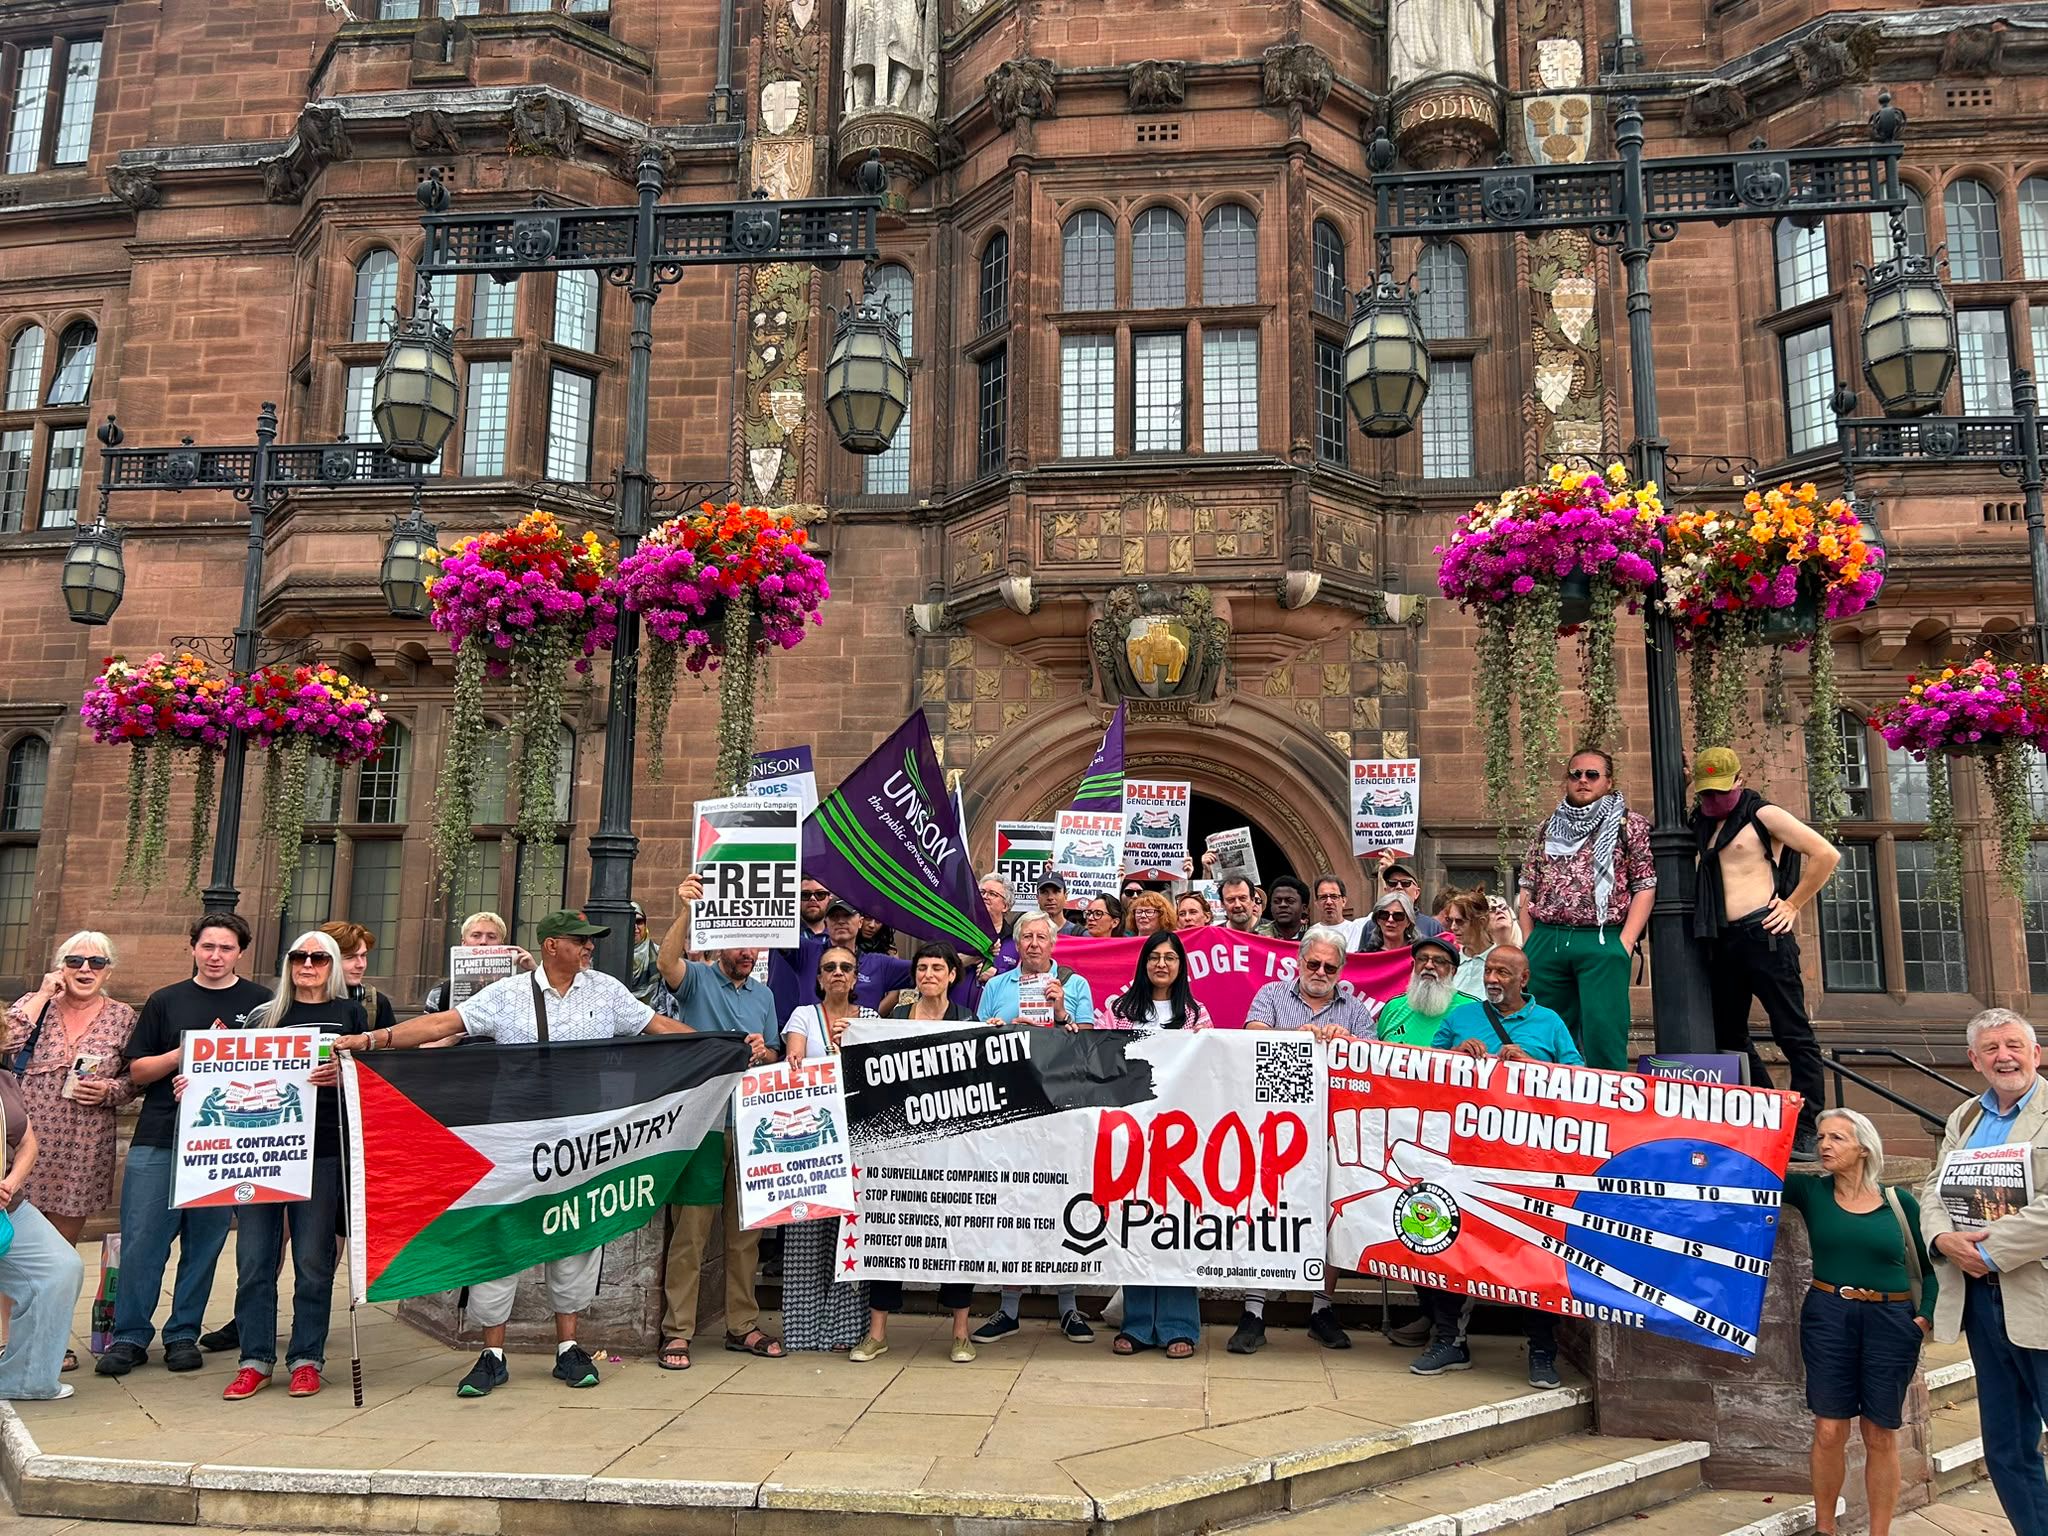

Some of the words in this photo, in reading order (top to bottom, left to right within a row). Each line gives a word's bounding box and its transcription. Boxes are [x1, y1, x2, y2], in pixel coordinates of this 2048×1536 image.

[749, 757, 800, 777] NISON
[1354, 763, 1416, 778] DELETE
[1354, 777, 1396, 785] GENOCIDE
[1126, 784, 1187, 800] DELETE
[701, 802, 728, 812] Palestine
[729, 801, 762, 810] Solidarity
[763, 800, 797, 810] Campaign
[1126, 797, 1165, 806] GENOCIDE
[1166, 798, 1186, 807] TECH
[883, 769, 957, 865] UNISON
[1061, 815, 1123, 831] DELETE
[1355, 821, 1380, 829] CANCEL
[1381, 820, 1414, 829] CONTRACTS
[1060, 827, 1098, 837] GENOCIDE
[1101, 829, 1121, 837] TECH
[1354, 829, 1373, 837] WITH
[1374, 829, 1394, 838] CISCO,
[1394, 828, 1415, 836] ORACLE
[867, 795, 884, 812] the
[878, 812, 907, 840] public
[904, 840, 925, 867] service
[922, 864, 940, 887] union
[1124, 841, 1147, 849] CANCEL
[1147, 842, 1183, 850] CONTRACTS
[1374, 837, 1404, 845] PALANTIR
[1140, 850, 1160, 859] CISCO,
[1140, 859, 1171, 867] PALANTIR
[695, 863, 796, 899] FREE
[1079, 871, 1117, 880] CONTRACTS
[1072, 880, 1091, 889] CISCO,
[1092, 881, 1117, 889] ORACLE
[695, 899, 795, 917] PALESTINE
[696, 920, 711, 929] END
[713, 919, 744, 928] ISRAELI
[745, 919, 794, 928] OCCUPATION
[472, 948, 513, 956] Socialist
[455, 959, 483, 968] PLANET
[484, 958, 511, 967] BURNS
[466, 966, 491, 975] PROFITS
[193, 1035, 311, 1061] DELETE
[192, 1059, 269, 1073] GENOCIDE
[273, 1059, 311, 1070] TECH
[864, 1039, 977, 1087] COVENTRY
[985, 1030, 1031, 1066] CITY
[741, 1062, 836, 1098] DELETE
[1327, 1037, 1498, 1090] COVENTRY
[1503, 1060, 1646, 1113] TRADES
[1653, 1079, 1783, 1131] UNION
[1330, 1077, 1346, 1090] EST
[1347, 1078, 1371, 1094] 1889
[742, 1089, 803, 1108] GENOCIDE
[804, 1084, 838, 1098] TECH
[904, 1082, 1008, 1126] COUNCIL:
[1454, 1101, 1613, 1160] COUNCIL
[186, 1138, 232, 1151] CANCEL
[236, 1134, 306, 1149] CONTRACTS
[531, 1104, 683, 1183] COVENTRY
[183, 1153, 218, 1167] WITH
[221, 1151, 259, 1166] CISCO,
[262, 1149, 308, 1162] ORACLE
[1972, 1147, 2025, 1160] Socialist
[747, 1163, 784, 1178] CANCEL
[786, 1153, 844, 1172] CONTRACTS
[1091, 1108, 1308, 1219] DROP
[1946, 1164, 1984, 1176] PLANET
[1982, 1163, 2023, 1177] BURNS
[207, 1168, 217, 1180] &
[221, 1165, 281, 1180] PALANTIR
[745, 1177, 774, 1192] WITH
[776, 1173, 807, 1188] CISCO,
[809, 1166, 847, 1182] ORACLE
[866, 1166, 879, 1179] NO
[881, 1167, 944, 1181] SURVEILLANCE
[946, 1169, 998, 1183] COMPANIES
[1000, 1171, 1009, 1183] IN
[1012, 1171, 1030, 1184] OUR
[1032, 1172, 1069, 1185] COUNCIL
[1554, 1174, 1566, 1188] A
[1597, 1177, 1666, 1197] WORLD
[1696, 1186, 1720, 1201] TO
[1752, 1189, 1778, 1206] WI
[1943, 1176, 1956, 1186] OIL
[1956, 1176, 1993, 1187] PROFITS
[1993, 1176, 2024, 1188] BOOM
[767, 1191, 775, 1202] &
[778, 1184, 827, 1201] PALANTIR
[865, 1188, 888, 1201] STOP
[890, 1190, 928, 1203] FUNDING
[930, 1191, 972, 1205] GENOCIDE
[975, 1192, 997, 1205] TECH
[1425, 1184, 1459, 1217] SUPPORT
[542, 1195, 580, 1235] ON
[586, 1173, 656, 1224] TOUR
[865, 1212, 896, 1225] PUBLIC
[898, 1213, 942, 1228] SERVICES,
[944, 1215, 962, 1228] NOT
[964, 1216, 994, 1228] PROFIT
[997, 1216, 1014, 1229] FOR
[1016, 1217, 1031, 1229] BIG
[1033, 1217, 1056, 1230] TECH
[1121, 1199, 1312, 1253] Palantir
[864, 1233, 902, 1247] PROTECT
[904, 1235, 922, 1248] OUR
[924, 1236, 947, 1249] DATA
[1414, 1236, 1453, 1254] WORKERS
[1523, 1196, 1555, 1218] THE
[1581, 1213, 1654, 1245] FUTURE
[1682, 1240, 1703, 1258] IS
[1734, 1254, 1771, 1277] OUR
[863, 1255, 906, 1269] WORKERS
[908, 1257, 920, 1270] TO
[922, 1258, 956, 1272] BENEFIT
[958, 1260, 985, 1273] FROM
[987, 1260, 999, 1274] AI,
[1001, 1261, 1019, 1273] NOT
[1021, 1261, 1033, 1273] BE
[1034, 1261, 1079, 1273] REPLACED
[1080, 1261, 1092, 1273] BY
[1094, 1261, 1102, 1273] IT
[1196, 1265, 1297, 1280] @drop_palantir_coventry
[1367, 1258, 1449, 1289] ORGANISE
[1467, 1279, 1540, 1307] AGITATE
[1560, 1297, 1646, 1329] EDUCATE
[1541, 1235, 1606, 1277] STRIKE
[1631, 1279, 1667, 1307] THE
[1692, 1308, 1750, 1348] BLOW
